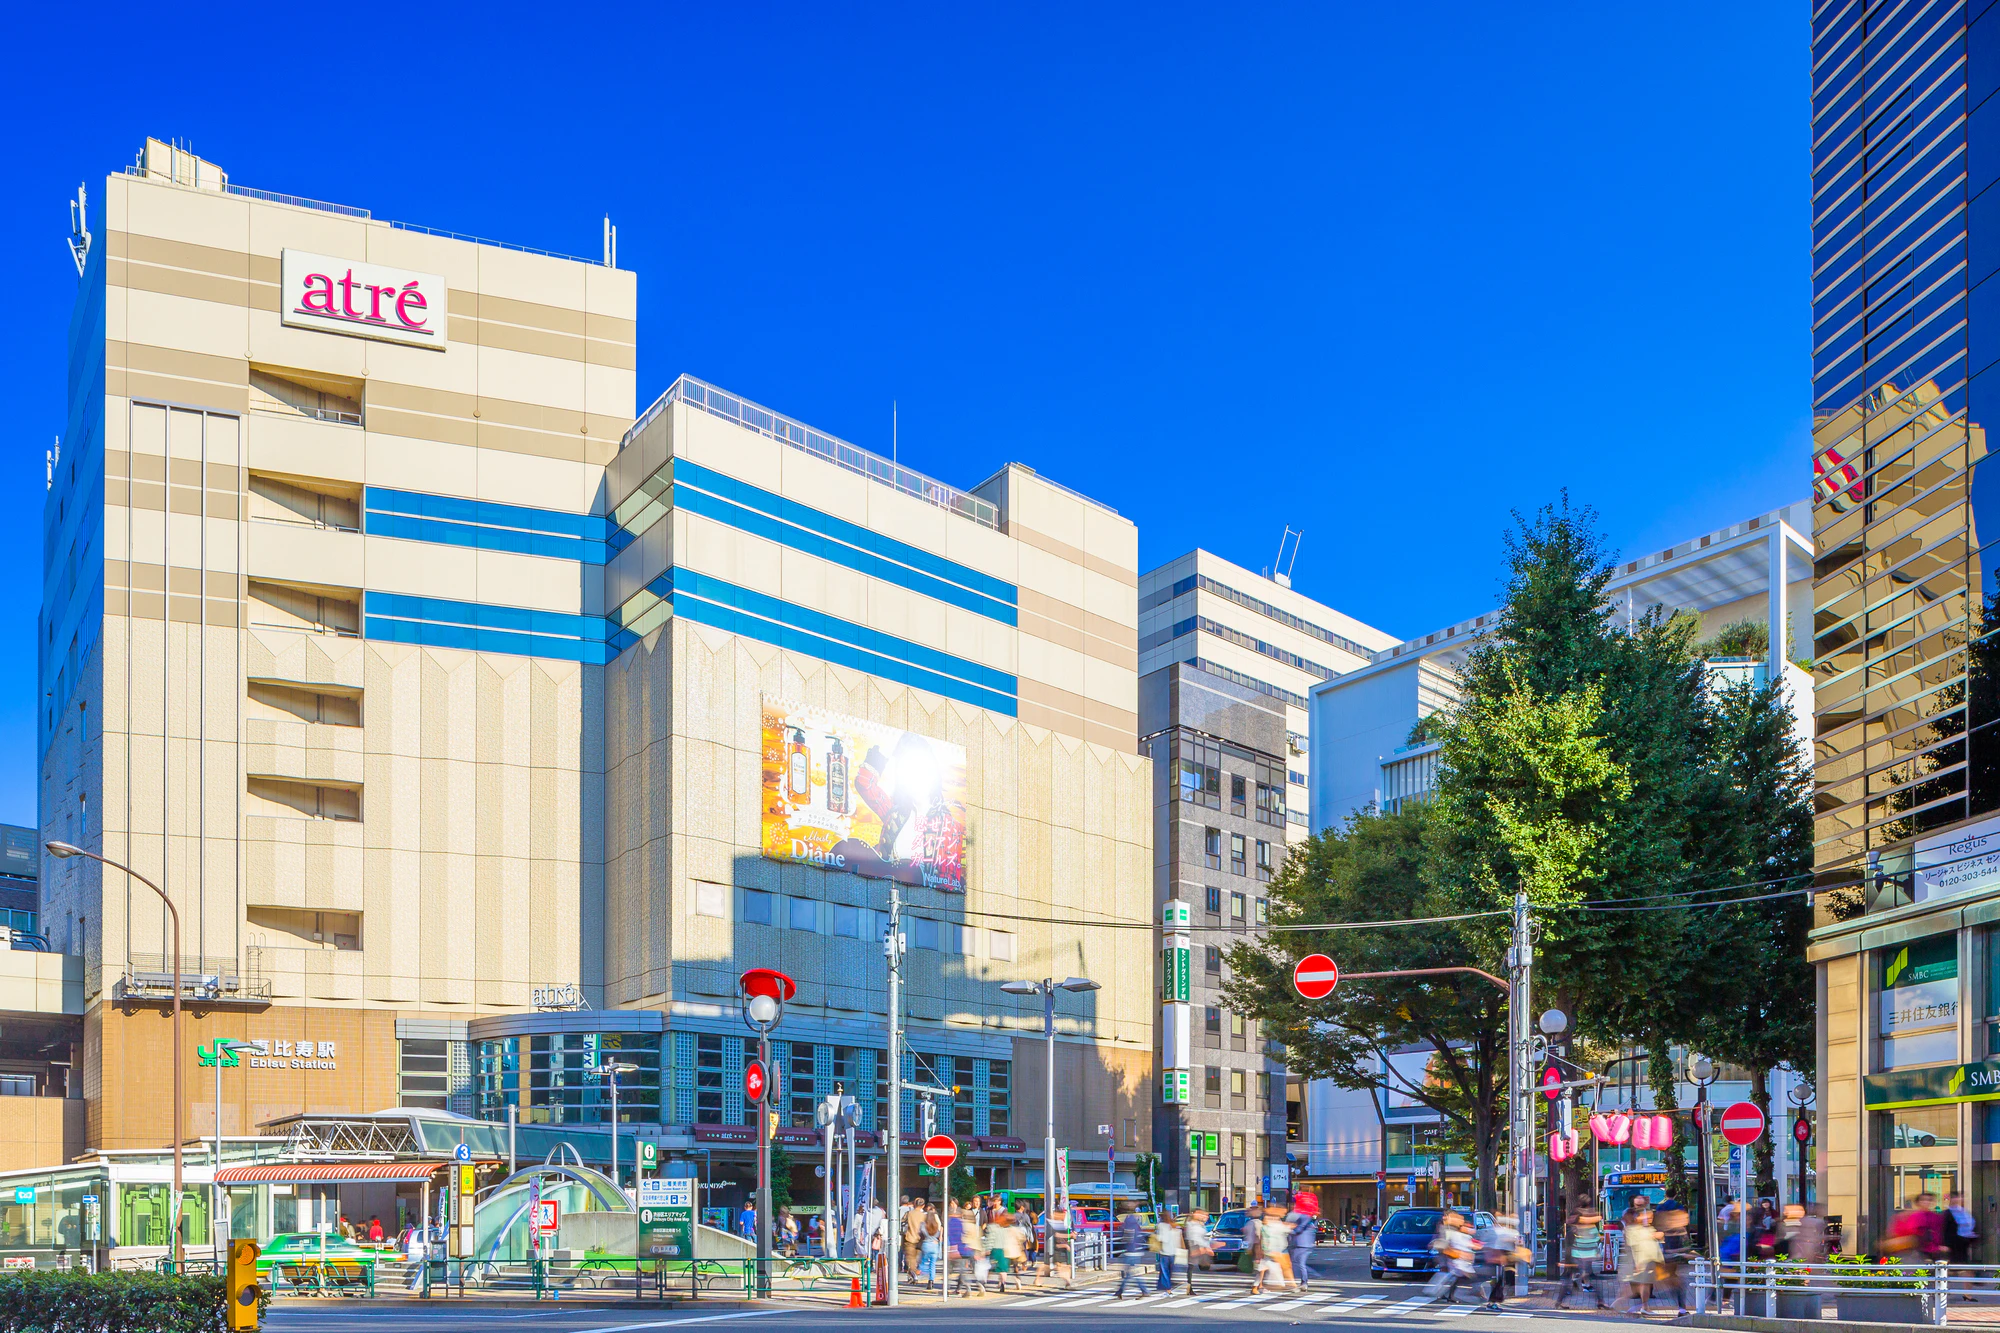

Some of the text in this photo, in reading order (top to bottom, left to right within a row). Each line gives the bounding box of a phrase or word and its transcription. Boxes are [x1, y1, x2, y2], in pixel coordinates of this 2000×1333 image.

[301, 268, 428, 329] atré
[911, 833, 957, 851] ダイアン
[1949, 837, 1987, 855] Regus
[910, 852, 961, 869] ガールズ。
[1925, 866, 1955, 881] リージャス
[1957, 858, 1983, 872] ビジネス
[1939, 865, 1998, 888] 0120-303-544
[1908, 969, 1929, 981] SMBC
[532, 982, 575, 1005] atré
[250, 1039, 336, 1058] 恵比寿駅
[250, 1058, 336, 1070] Ebisu Station
[461, 1145, 469, 1160] 3
[1733, 1148, 1741, 1159] 4
